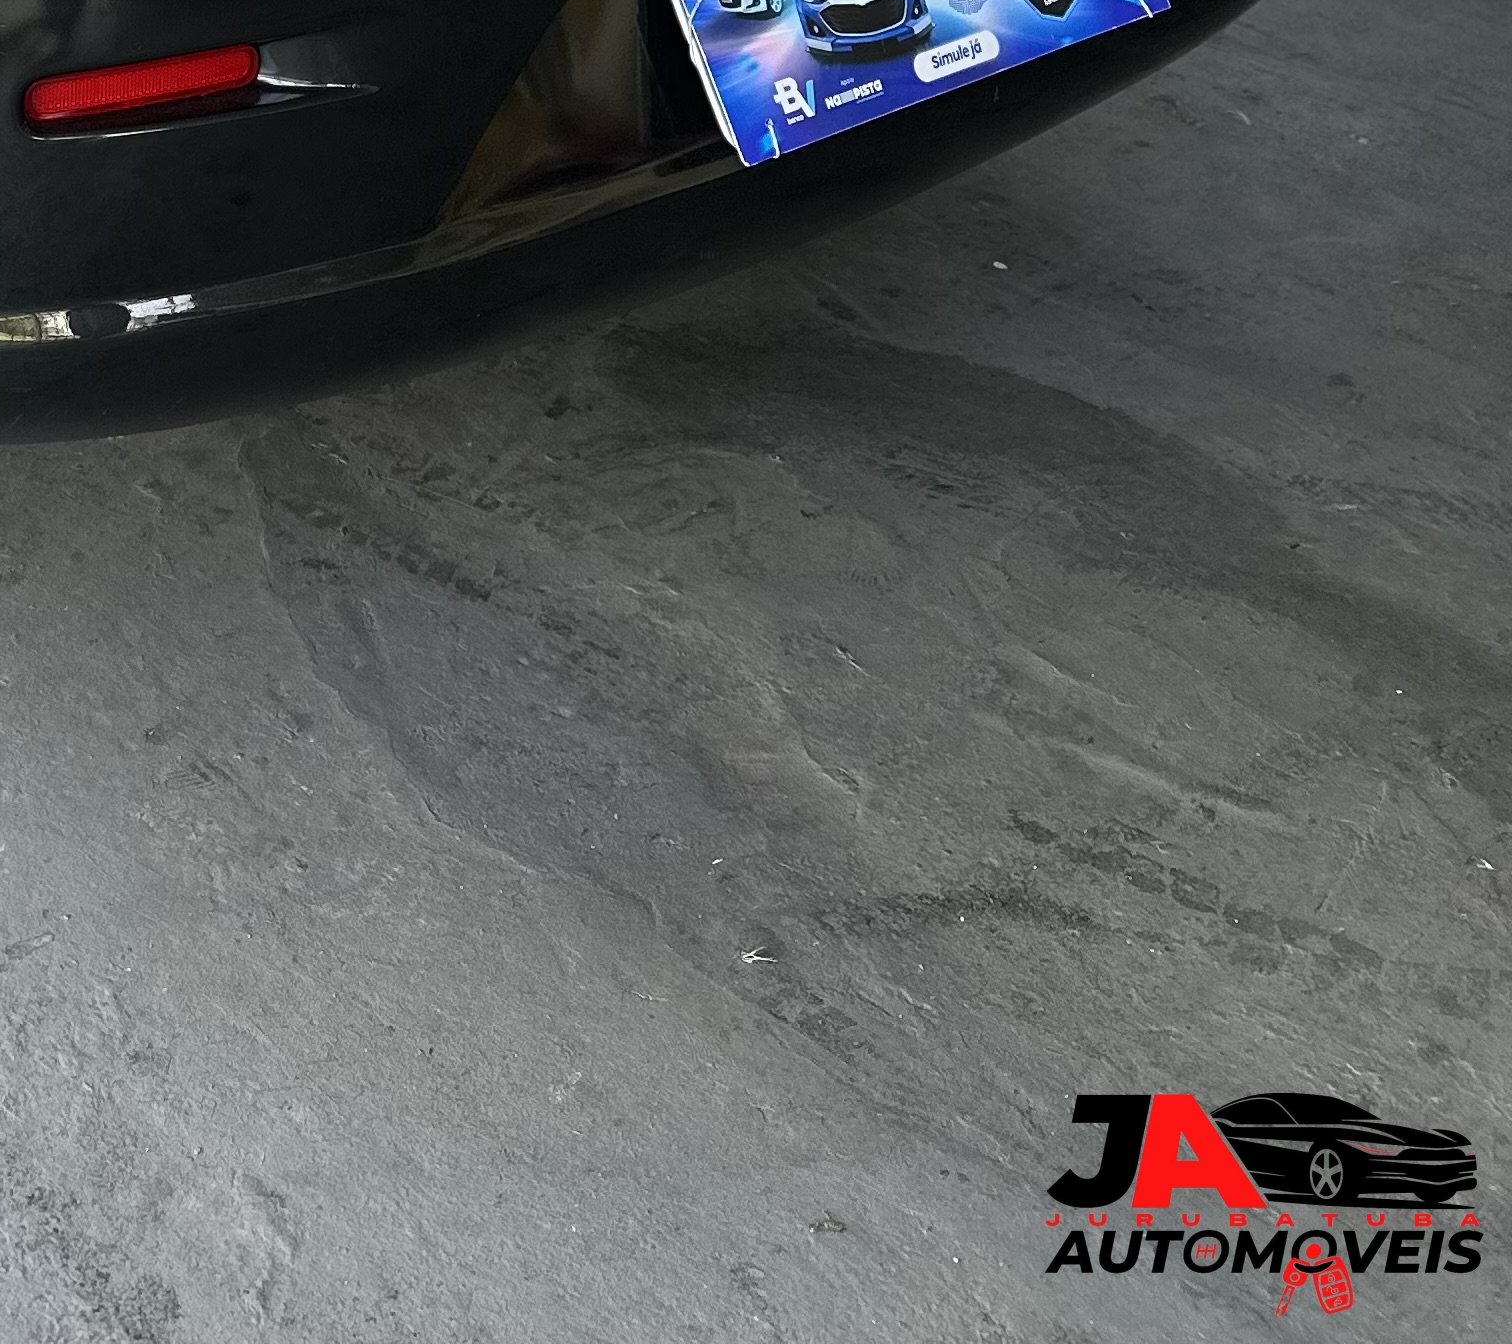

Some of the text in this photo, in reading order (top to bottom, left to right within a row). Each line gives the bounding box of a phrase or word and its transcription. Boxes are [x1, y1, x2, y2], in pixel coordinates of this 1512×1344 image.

[931, 38, 982, 69] Simule já
[773, 77, 816, 118] BV
